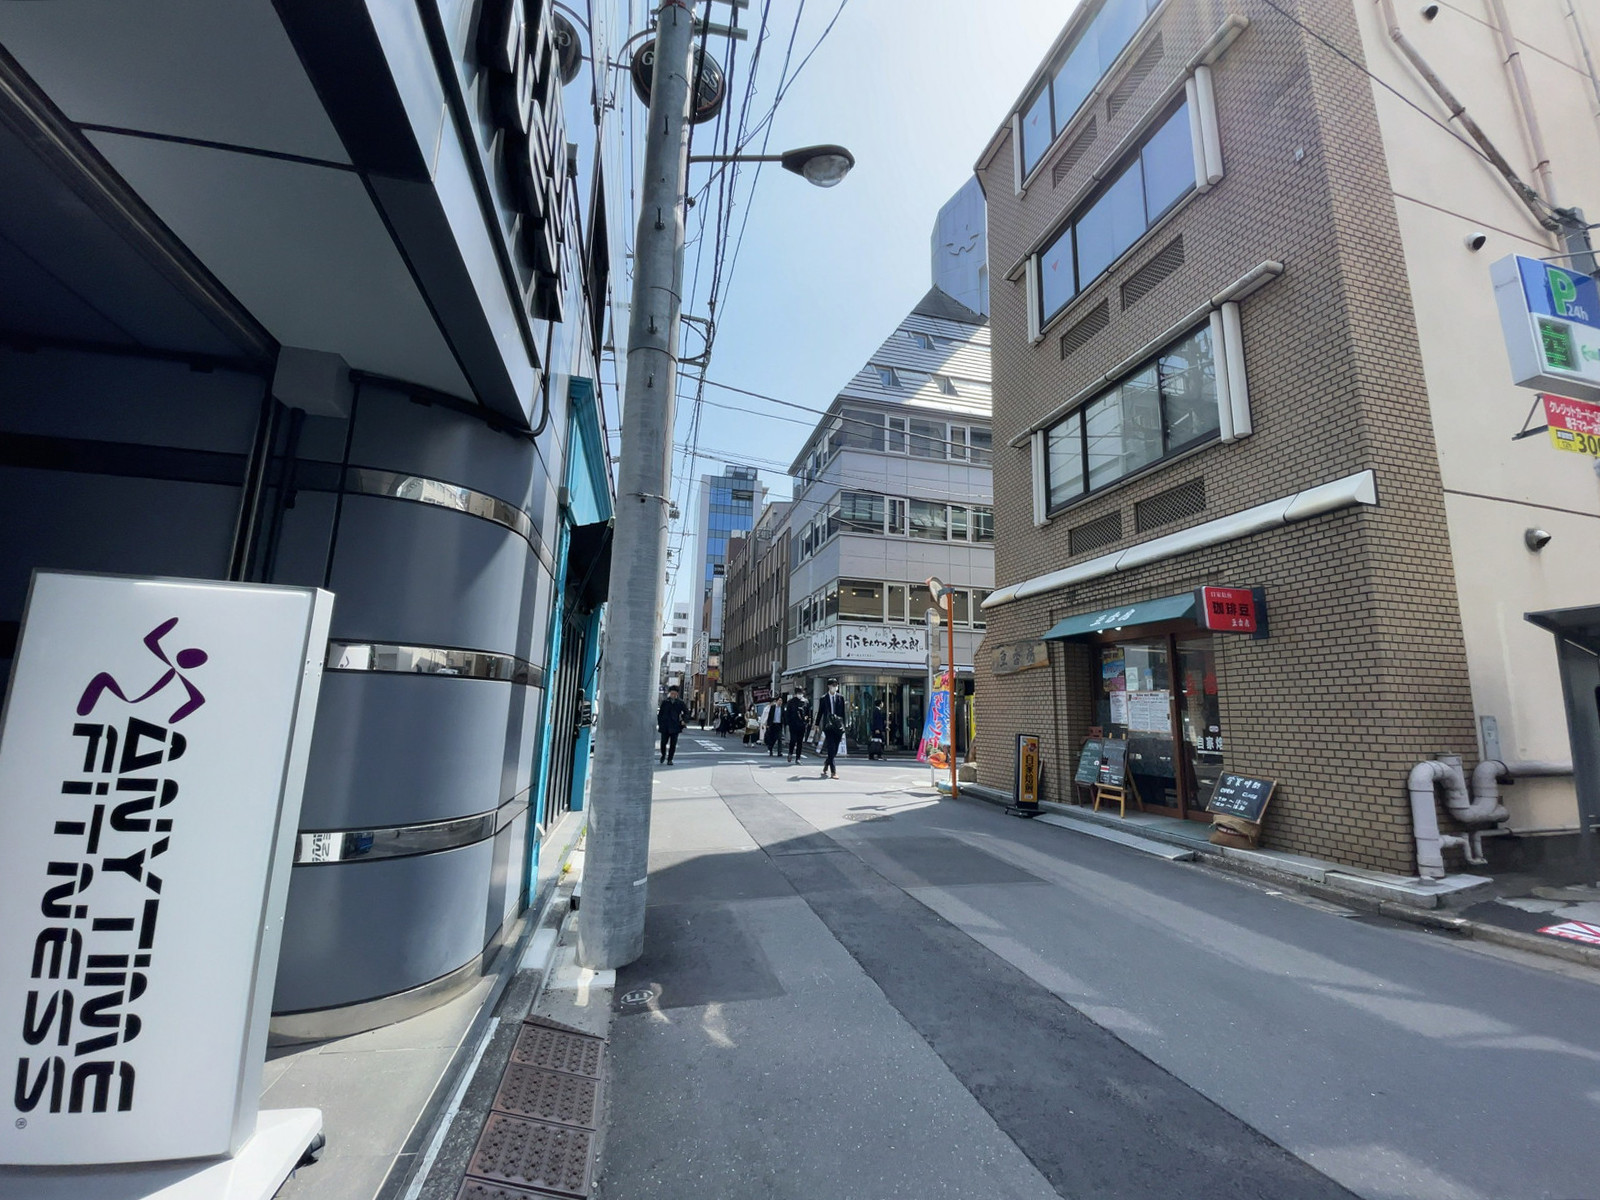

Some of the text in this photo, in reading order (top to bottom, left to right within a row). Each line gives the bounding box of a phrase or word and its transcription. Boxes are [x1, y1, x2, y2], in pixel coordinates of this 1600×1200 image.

[1546, 266, 1577, 316] P
[1565, 303, 1589, 322] 24h
[1576, 432, 1600, 456] 30
[1212, 601, 1250, 617] 珈琲豆
[14, 722, 119, 1114] FITNESS
[68, 717, 187, 1114] ANYTIME
